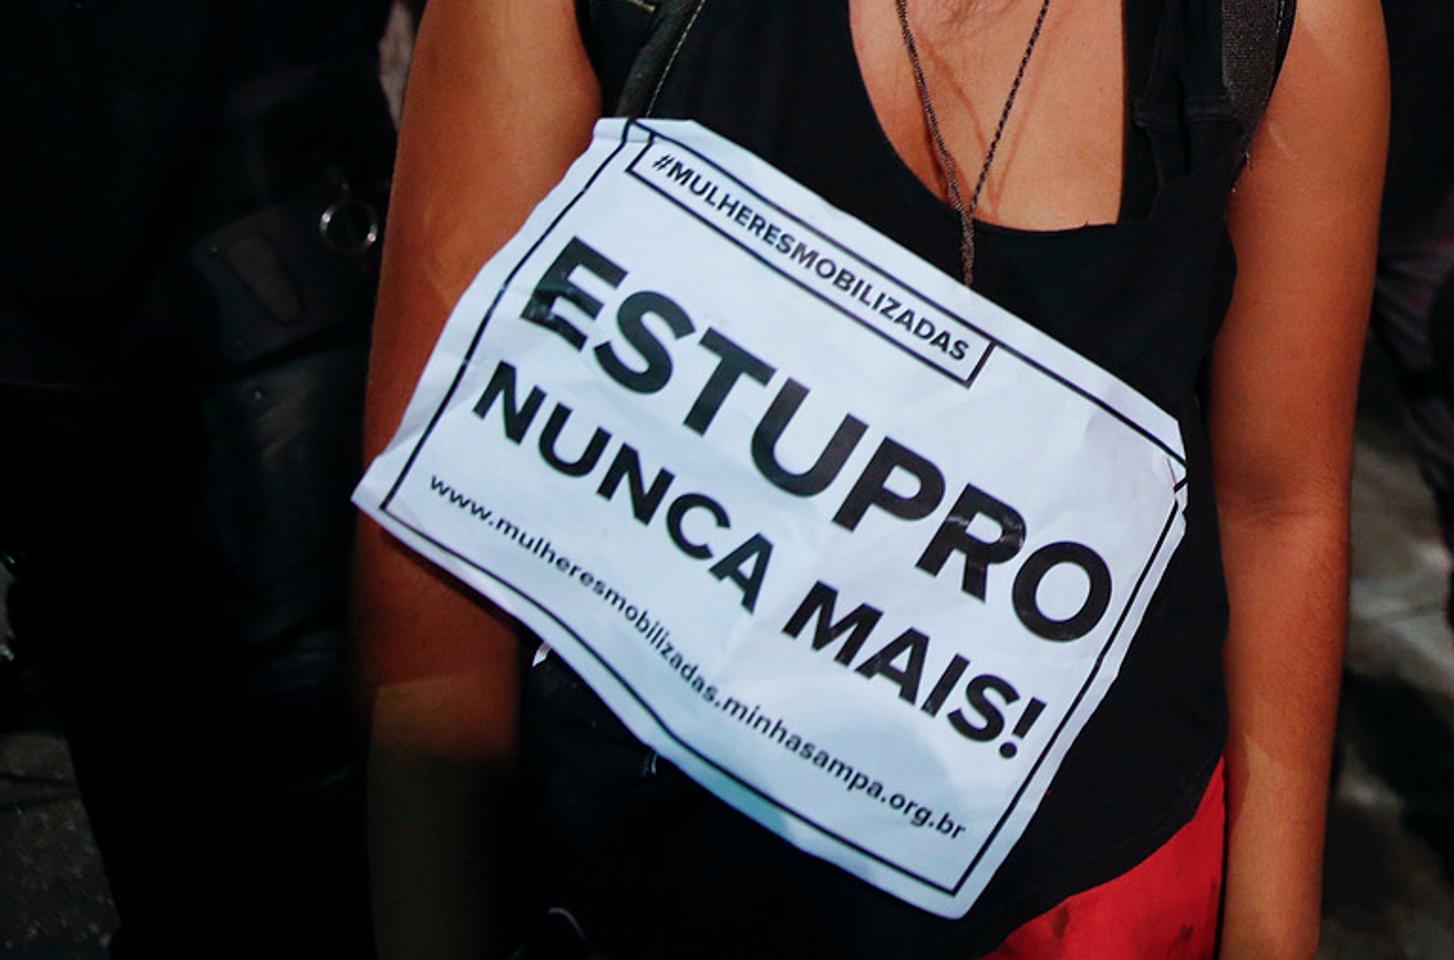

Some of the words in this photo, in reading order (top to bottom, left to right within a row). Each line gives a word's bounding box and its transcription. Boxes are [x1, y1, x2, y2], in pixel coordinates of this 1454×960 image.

[520, 235, 1113, 642] ESTUPRO
[652, 153, 970, 362] #MULHERESMOBILIZADAS
[430, 474, 966, 839] www.mulheresmobilizadas.minhasampa.org.br
[472, 360, 774, 614] NUNCA
[782, 580, 1047, 760] MAIS!
